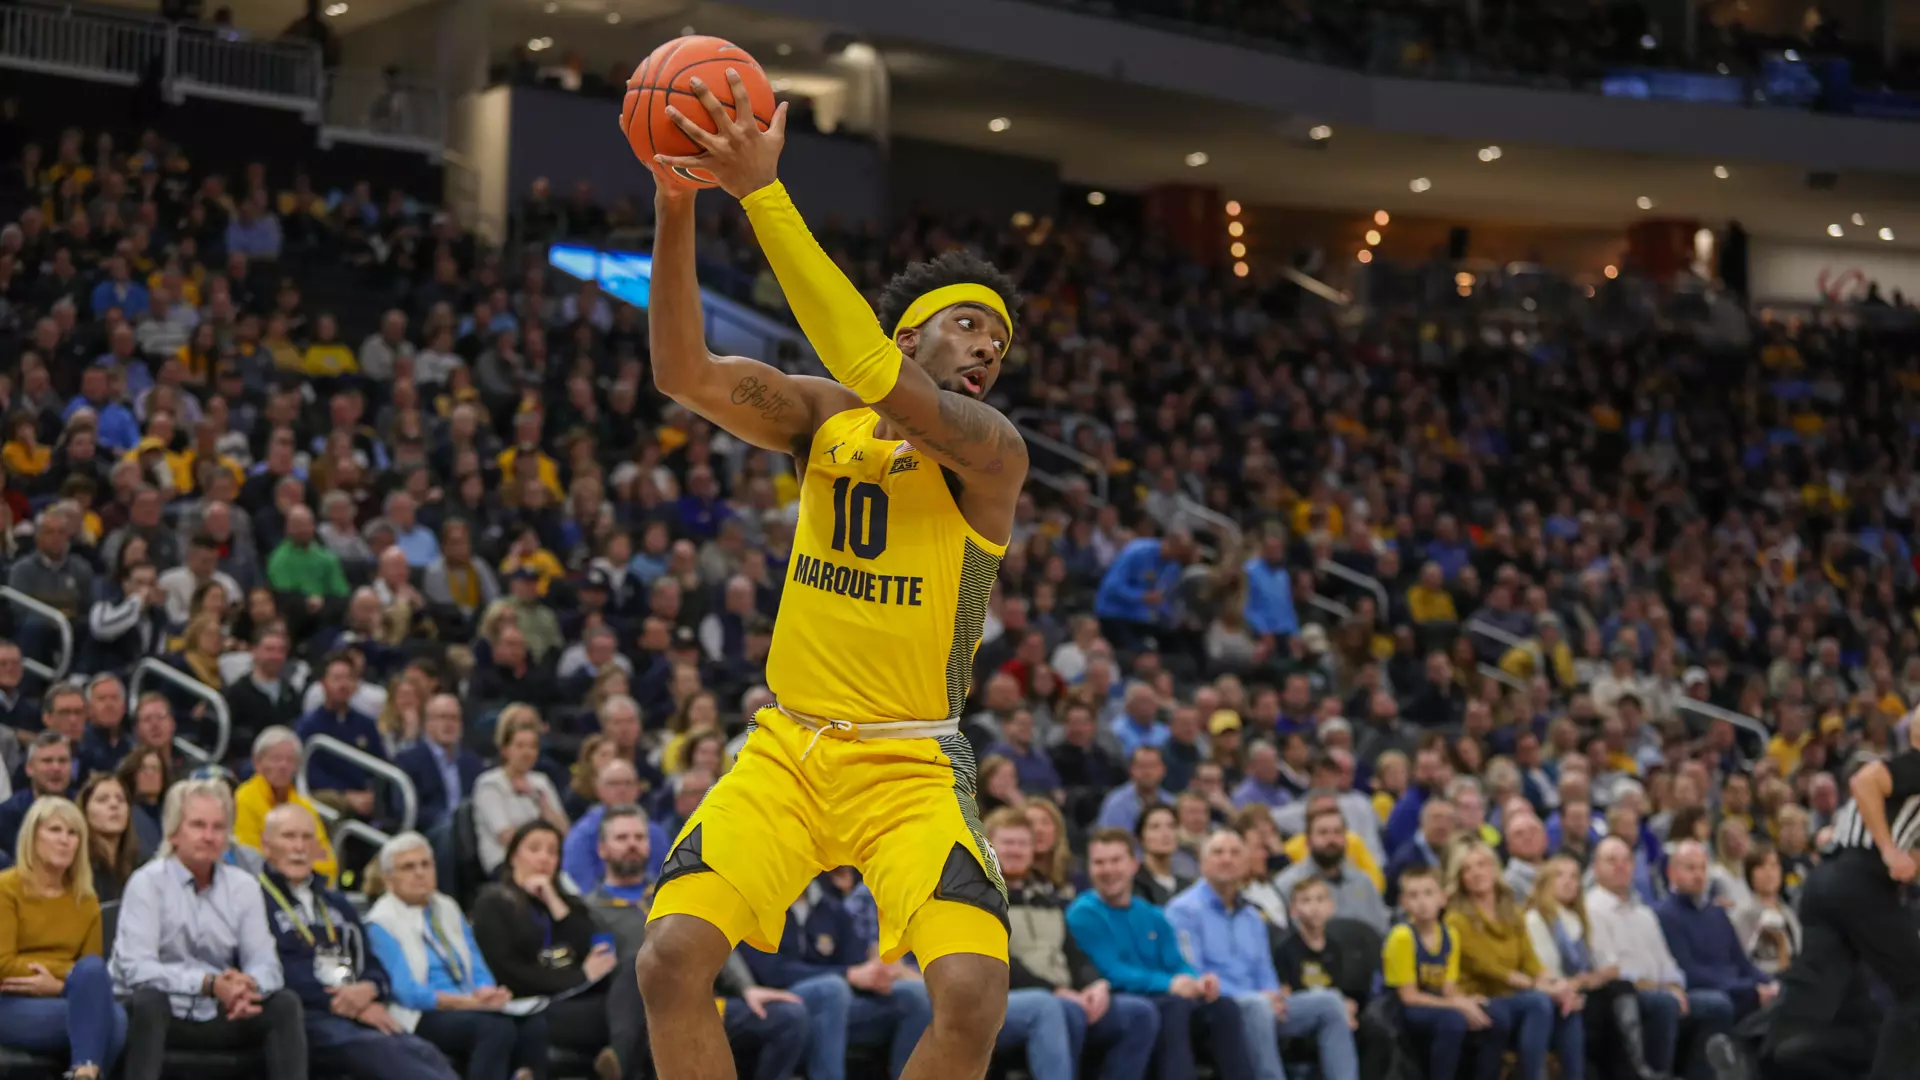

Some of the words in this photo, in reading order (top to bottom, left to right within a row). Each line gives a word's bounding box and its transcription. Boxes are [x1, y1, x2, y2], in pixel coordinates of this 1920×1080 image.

[851, 450, 864, 461] AL
[894, 456, 913, 466] BIG
[890, 461, 920, 473] EAST
[831, 476, 889, 560] 10
[793, 553, 923, 606] MARQUETTE
